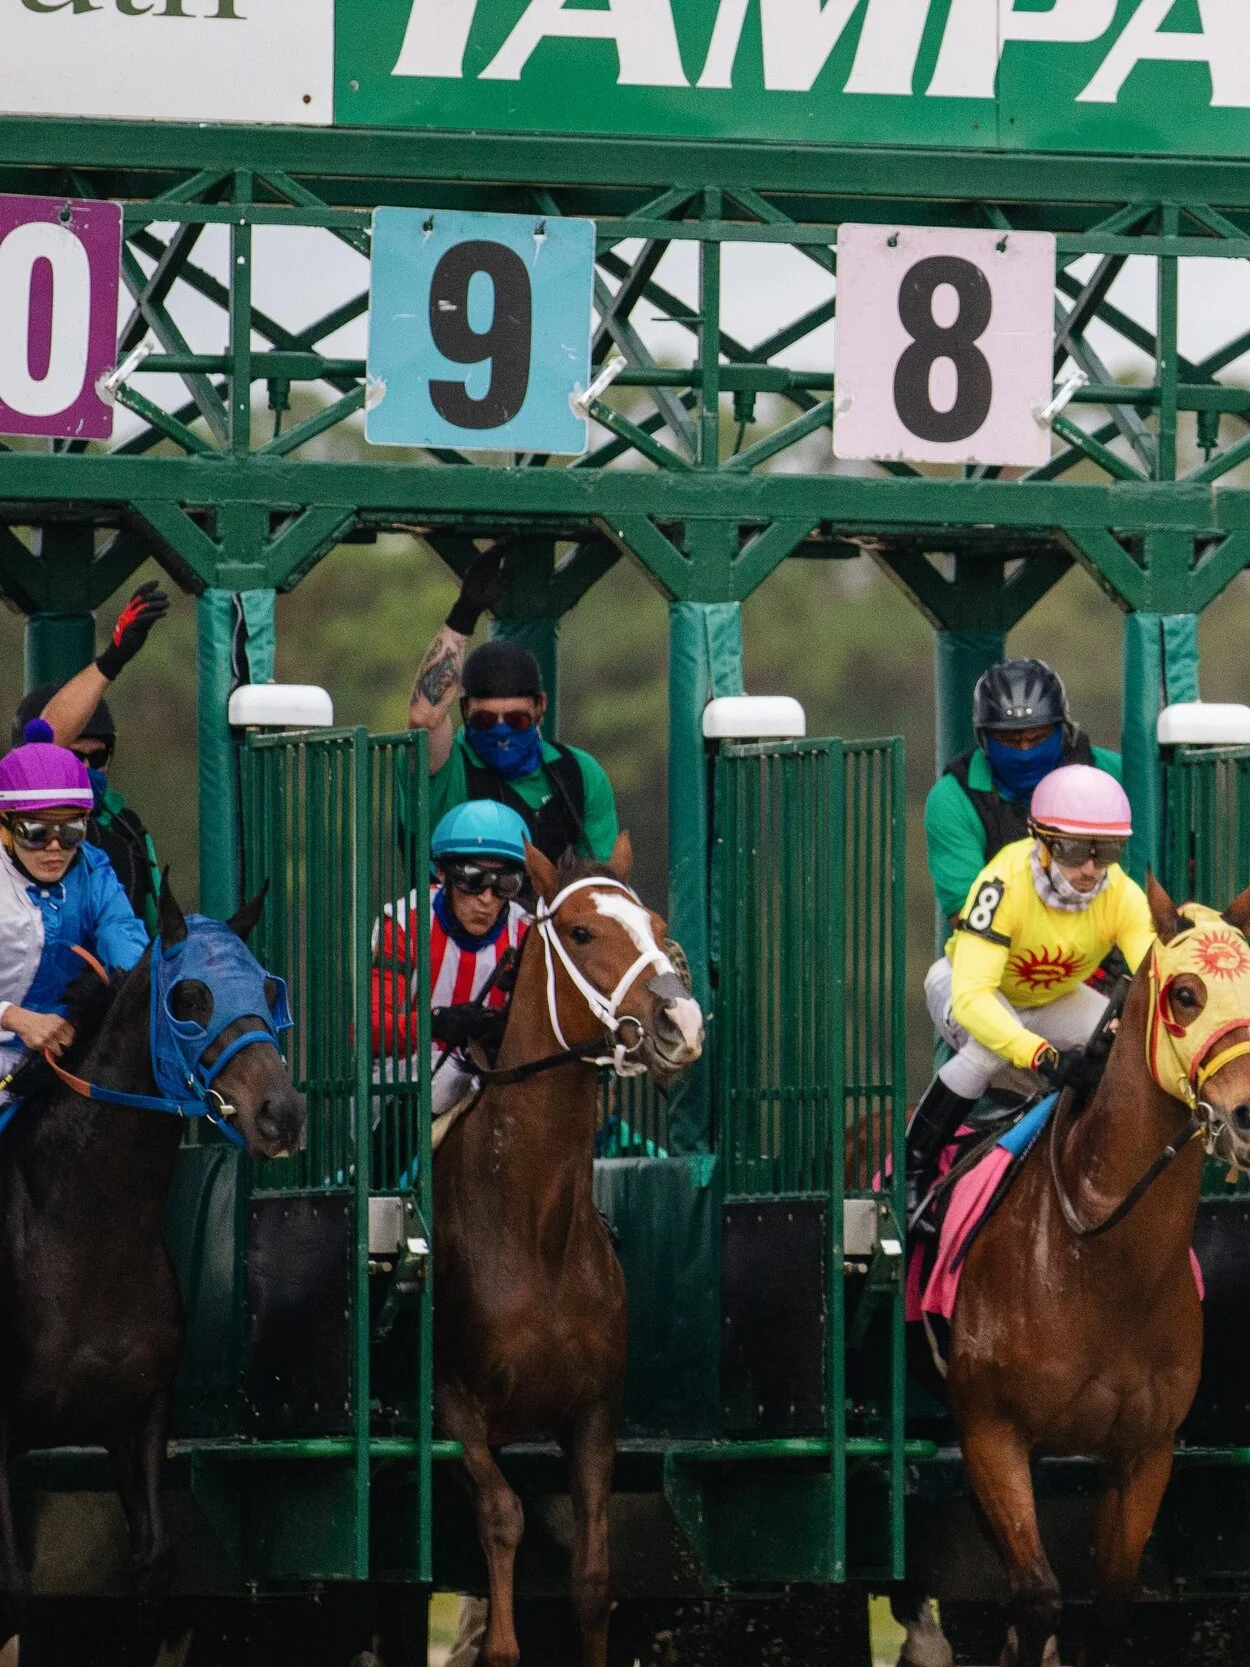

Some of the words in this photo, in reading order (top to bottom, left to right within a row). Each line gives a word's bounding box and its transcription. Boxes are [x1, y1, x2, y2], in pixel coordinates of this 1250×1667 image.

[428, 239, 533, 430] 9
[893, 255, 994, 444] 8
[969, 886, 1000, 931] 8
